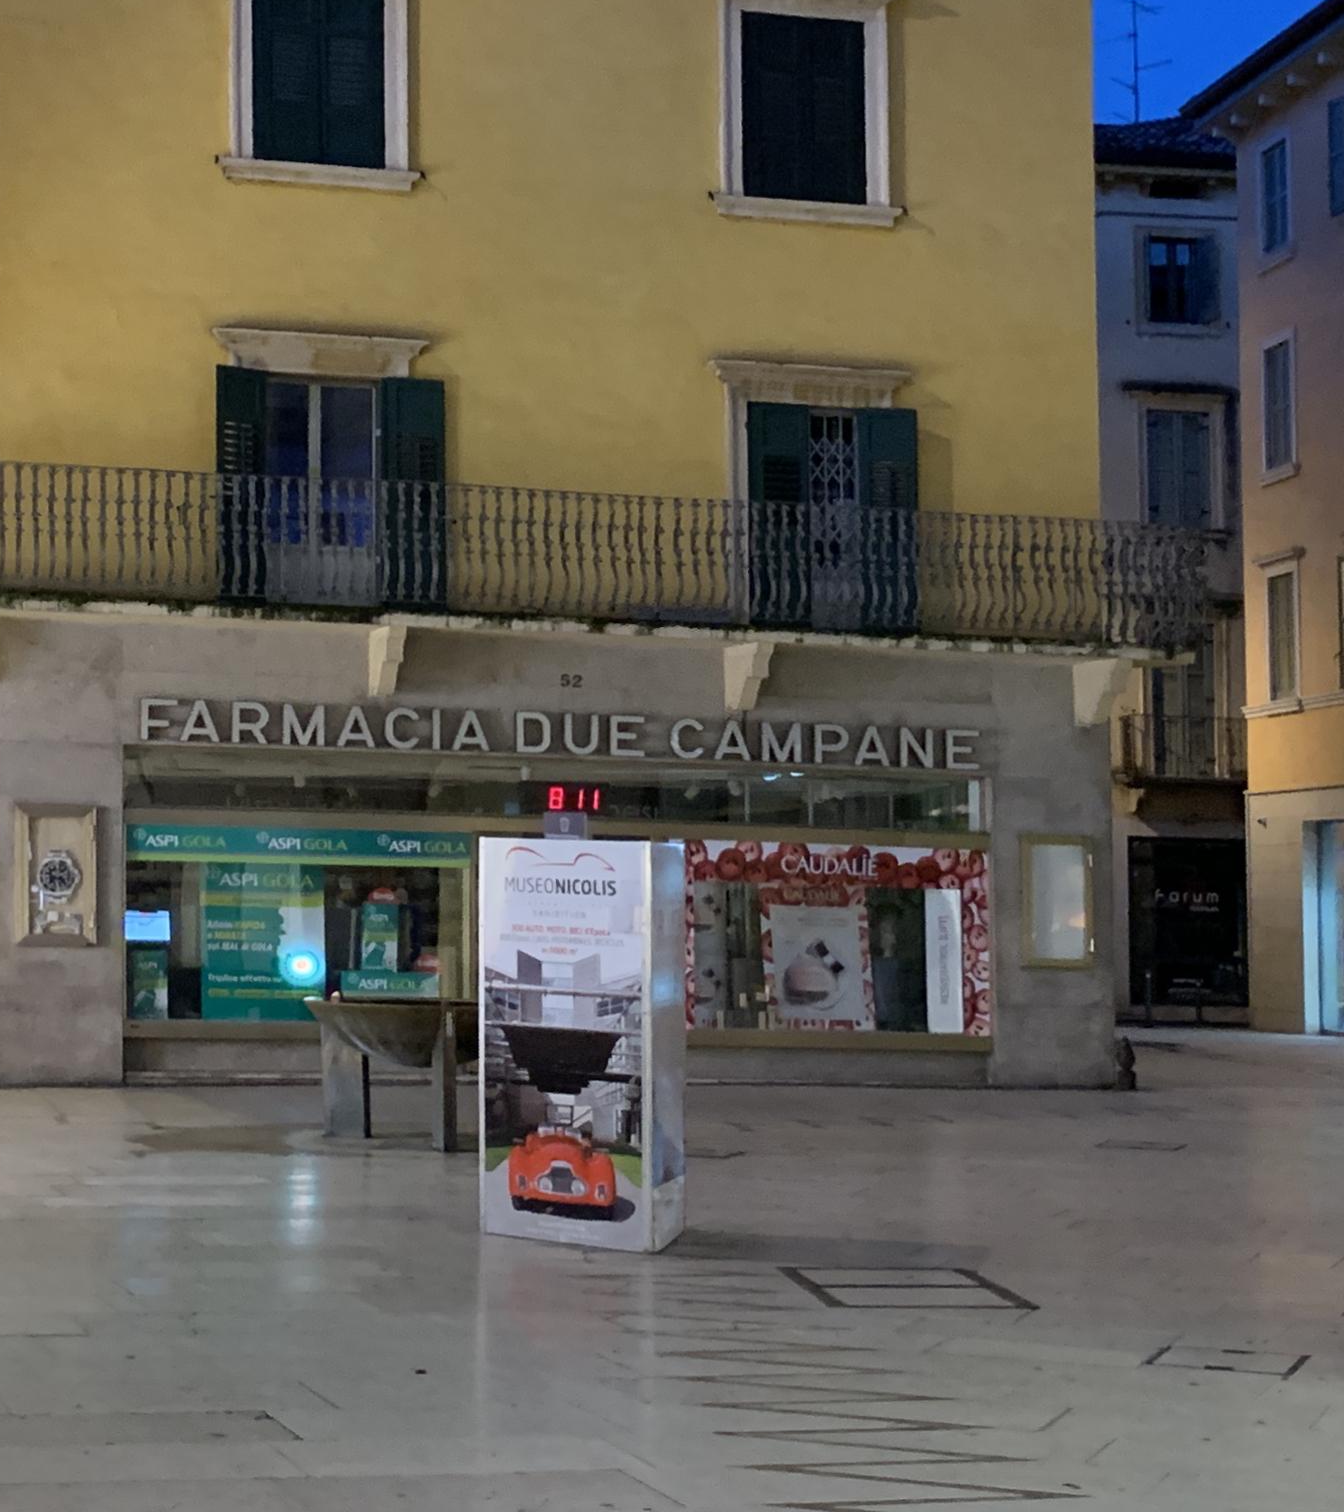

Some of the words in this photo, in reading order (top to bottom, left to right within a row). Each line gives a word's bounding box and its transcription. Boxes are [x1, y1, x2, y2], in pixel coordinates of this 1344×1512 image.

[559, 673, 583, 688] 52
[140, 697, 490, 752] FARMACIA
[515, 711, 646, 757] DUE
[669, 718, 981, 770] CAMPANE
[145, 834, 179, 848] ASPI
[182, 834, 226, 848] GOLA
[268, 837, 301, 850] ASPI
[304, 838, 348, 852] GOLA
[388, 839, 421, 853] ASPI
[425, 840, 467, 854] GOLA
[219, 872, 258, 887] ASPI
